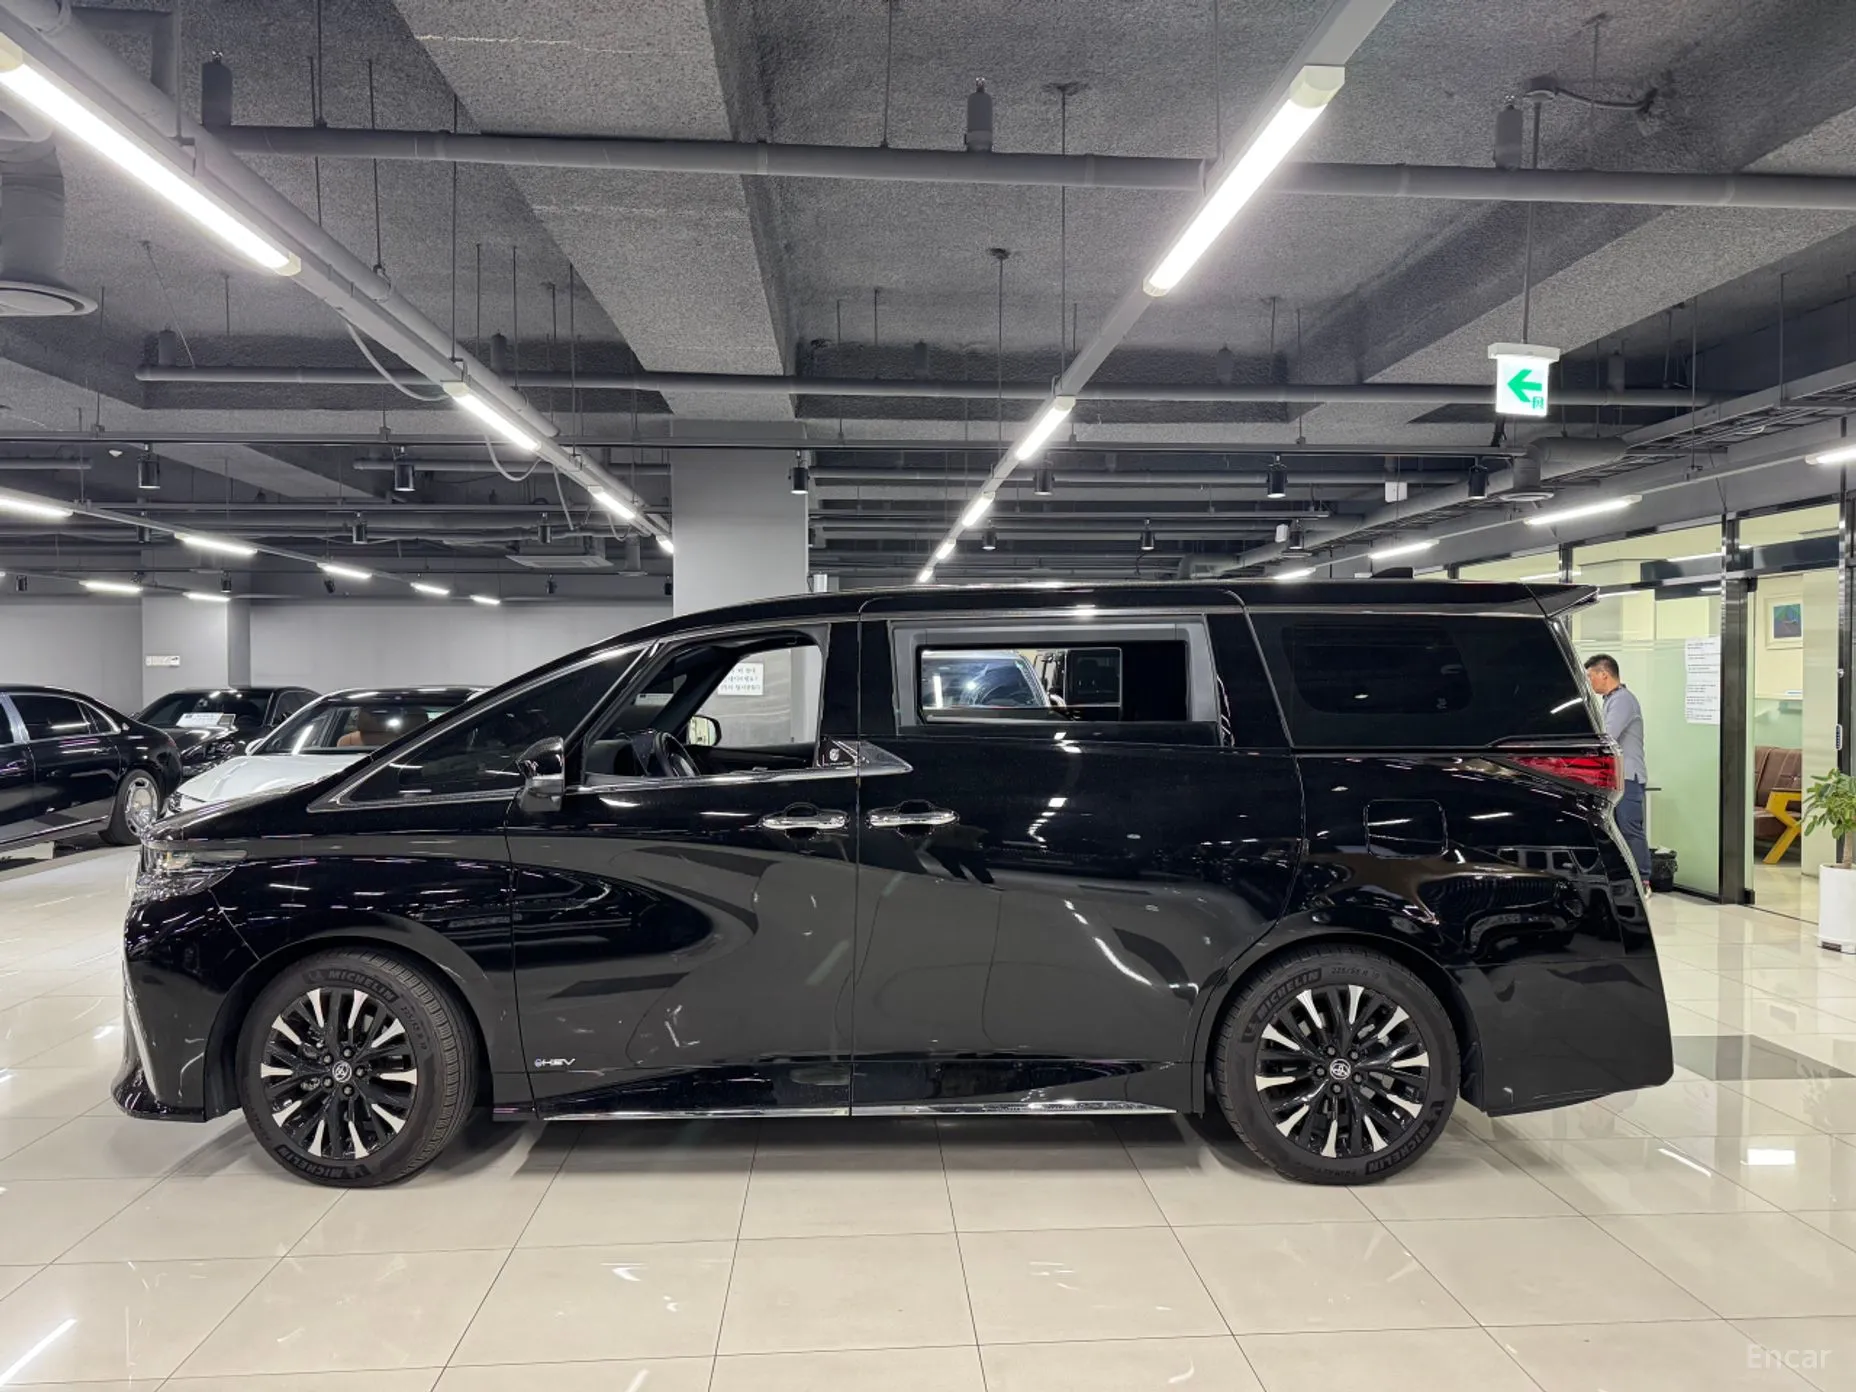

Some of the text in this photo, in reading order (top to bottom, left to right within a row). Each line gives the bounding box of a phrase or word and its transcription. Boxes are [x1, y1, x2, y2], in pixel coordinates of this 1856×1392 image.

[328, 969, 397, 1002] MICHELIN
[1257, 970, 1320, 1017] MICHELIN
[279, 1146, 343, 1178] MICHELIN
[1367, 1121, 1430, 1174] MICHELIN
